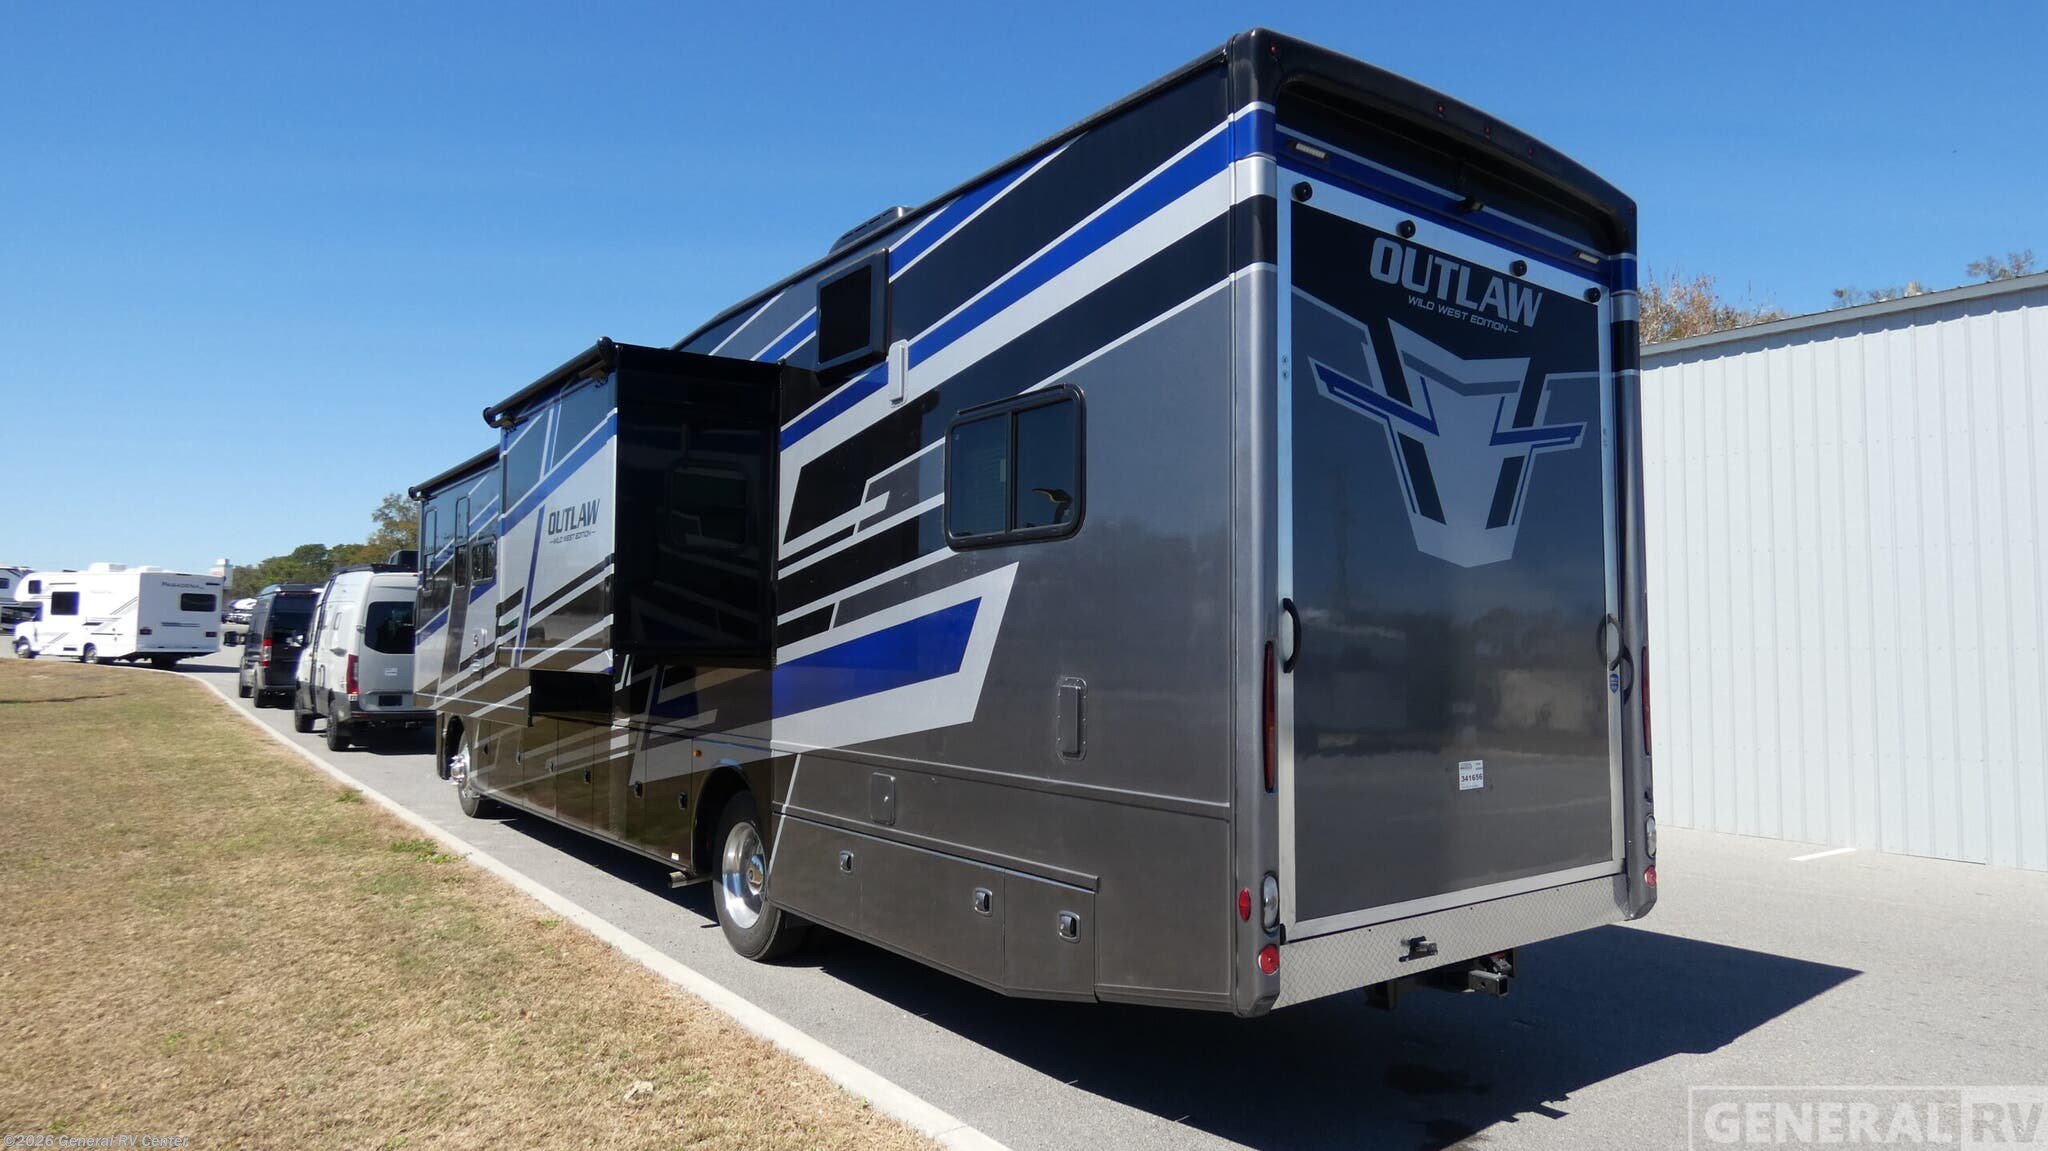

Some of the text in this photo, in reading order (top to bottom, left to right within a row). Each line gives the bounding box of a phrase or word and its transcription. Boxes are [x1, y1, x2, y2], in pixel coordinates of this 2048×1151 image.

[1369, 237, 1543, 328] OUTLAW
[1408, 295, 1510, 334] WILD WEST EDITION
[548, 498, 600, 535] OUTLAW
